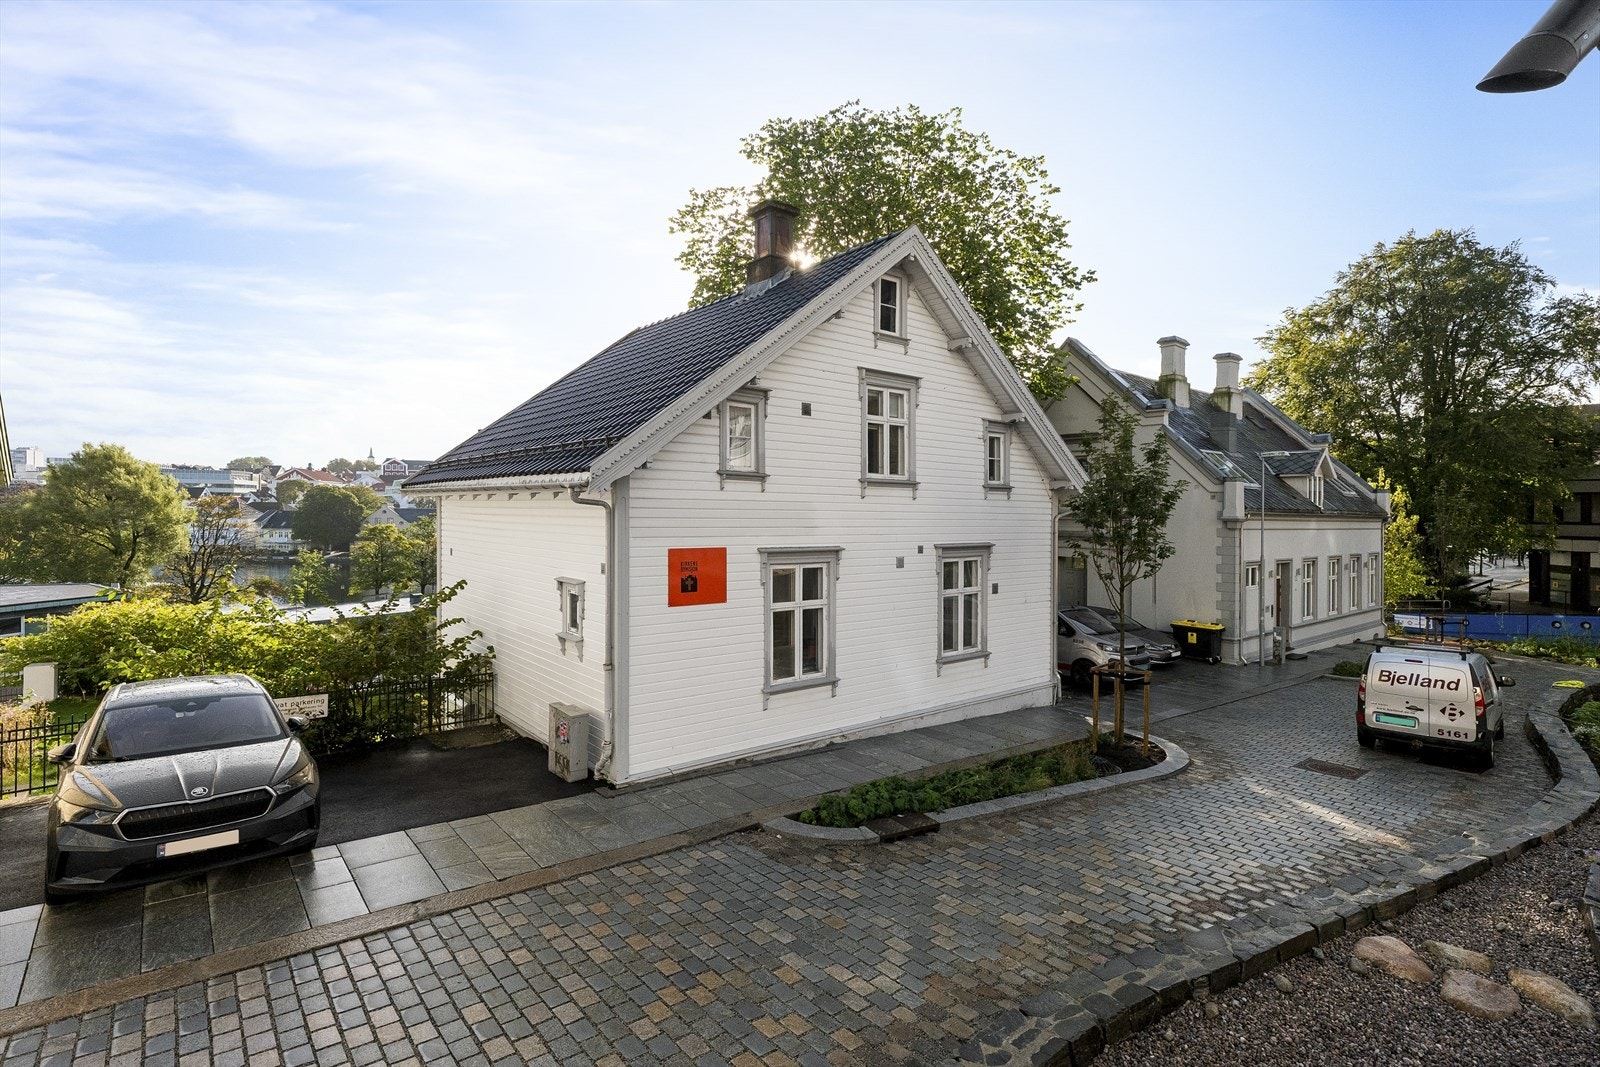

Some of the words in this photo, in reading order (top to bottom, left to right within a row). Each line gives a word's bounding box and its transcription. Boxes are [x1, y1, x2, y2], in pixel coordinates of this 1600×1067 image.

[1378, 670, 1461, 691] Bjelland
[290, 698, 325, 707] parkering
[1437, 728, 1469, 740] 5161
